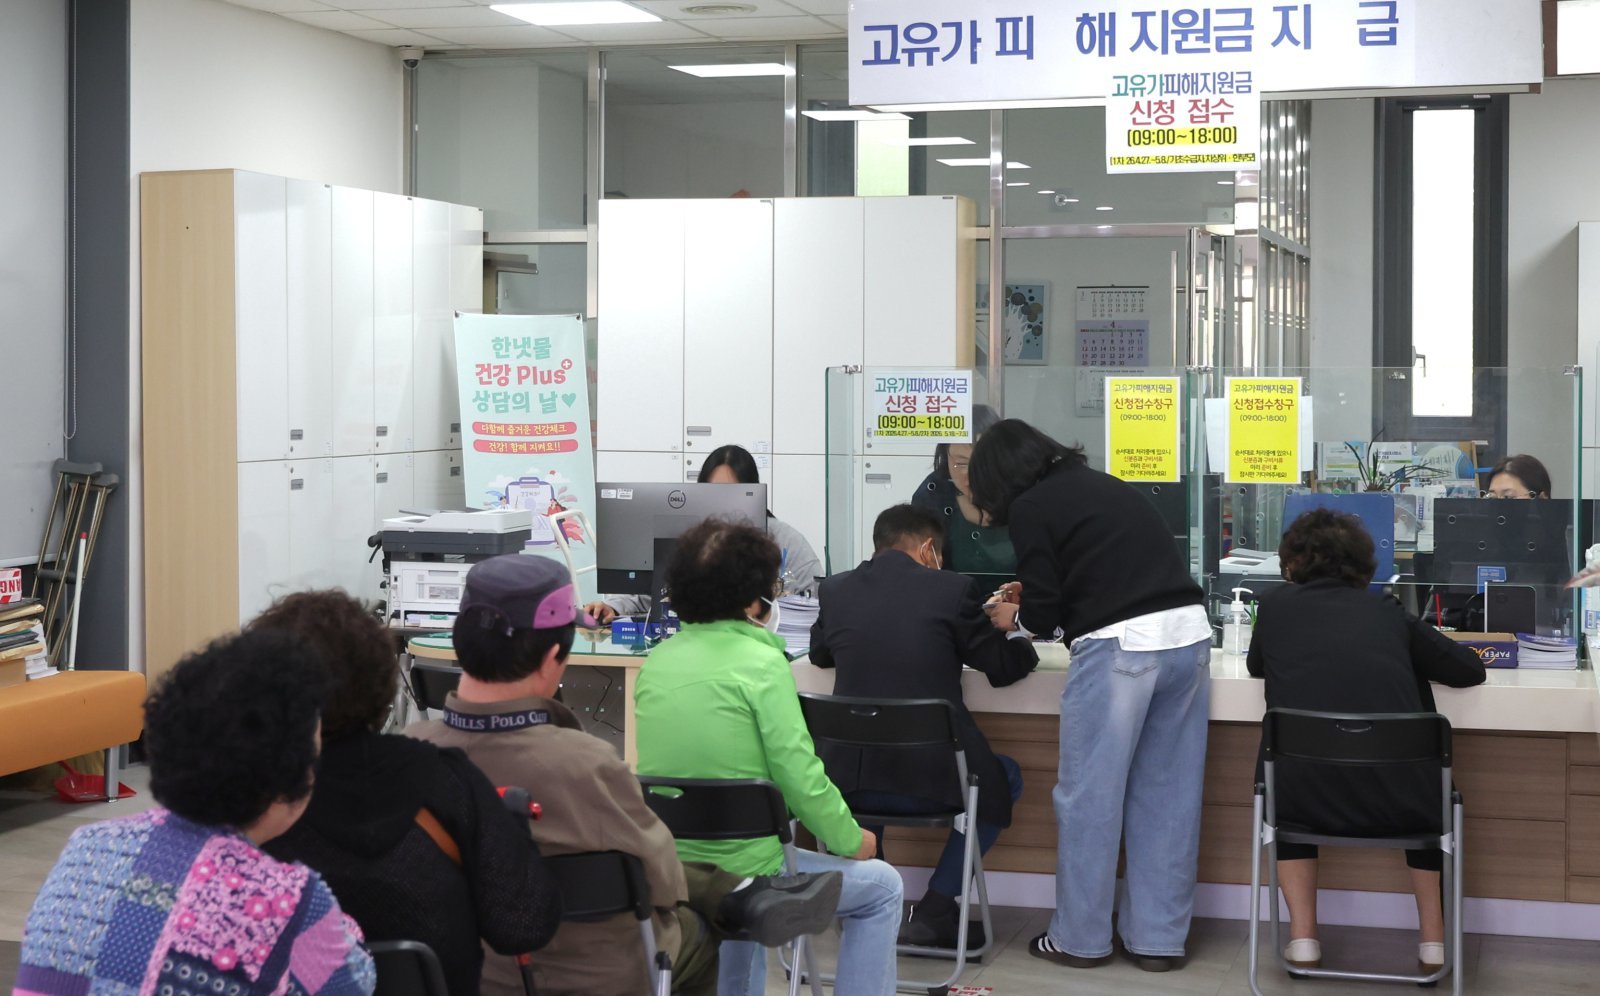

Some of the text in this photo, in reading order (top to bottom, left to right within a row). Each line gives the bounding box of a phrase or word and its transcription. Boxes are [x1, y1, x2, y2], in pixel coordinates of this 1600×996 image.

[1112, 71, 1252, 97] 고유가피해지원금
[1129, 97, 1234, 126] 신청 접수
[491, 336, 552, 360] 한냇물
[475, 363, 511, 387] 건강
[875, 378, 968, 394] 고유가피해지원금
[1114, 384, 1173, 393] 고유가피해지원금
[1234, 384, 1294, 394] 고유가피해지원금
[472, 390, 558, 415] 상담의 날
[885, 395, 957, 414] 신청 접수
[1114, 398, 1173, 410] 신청접수창구
[1234, 398, 1295, 411] 신청접수창구
[507, 425, 531, 435] 즐거운
[510, 443, 528, 453] 함께
[451, 711, 485, 730] HILLS
[491, 714, 525, 729] POLO
